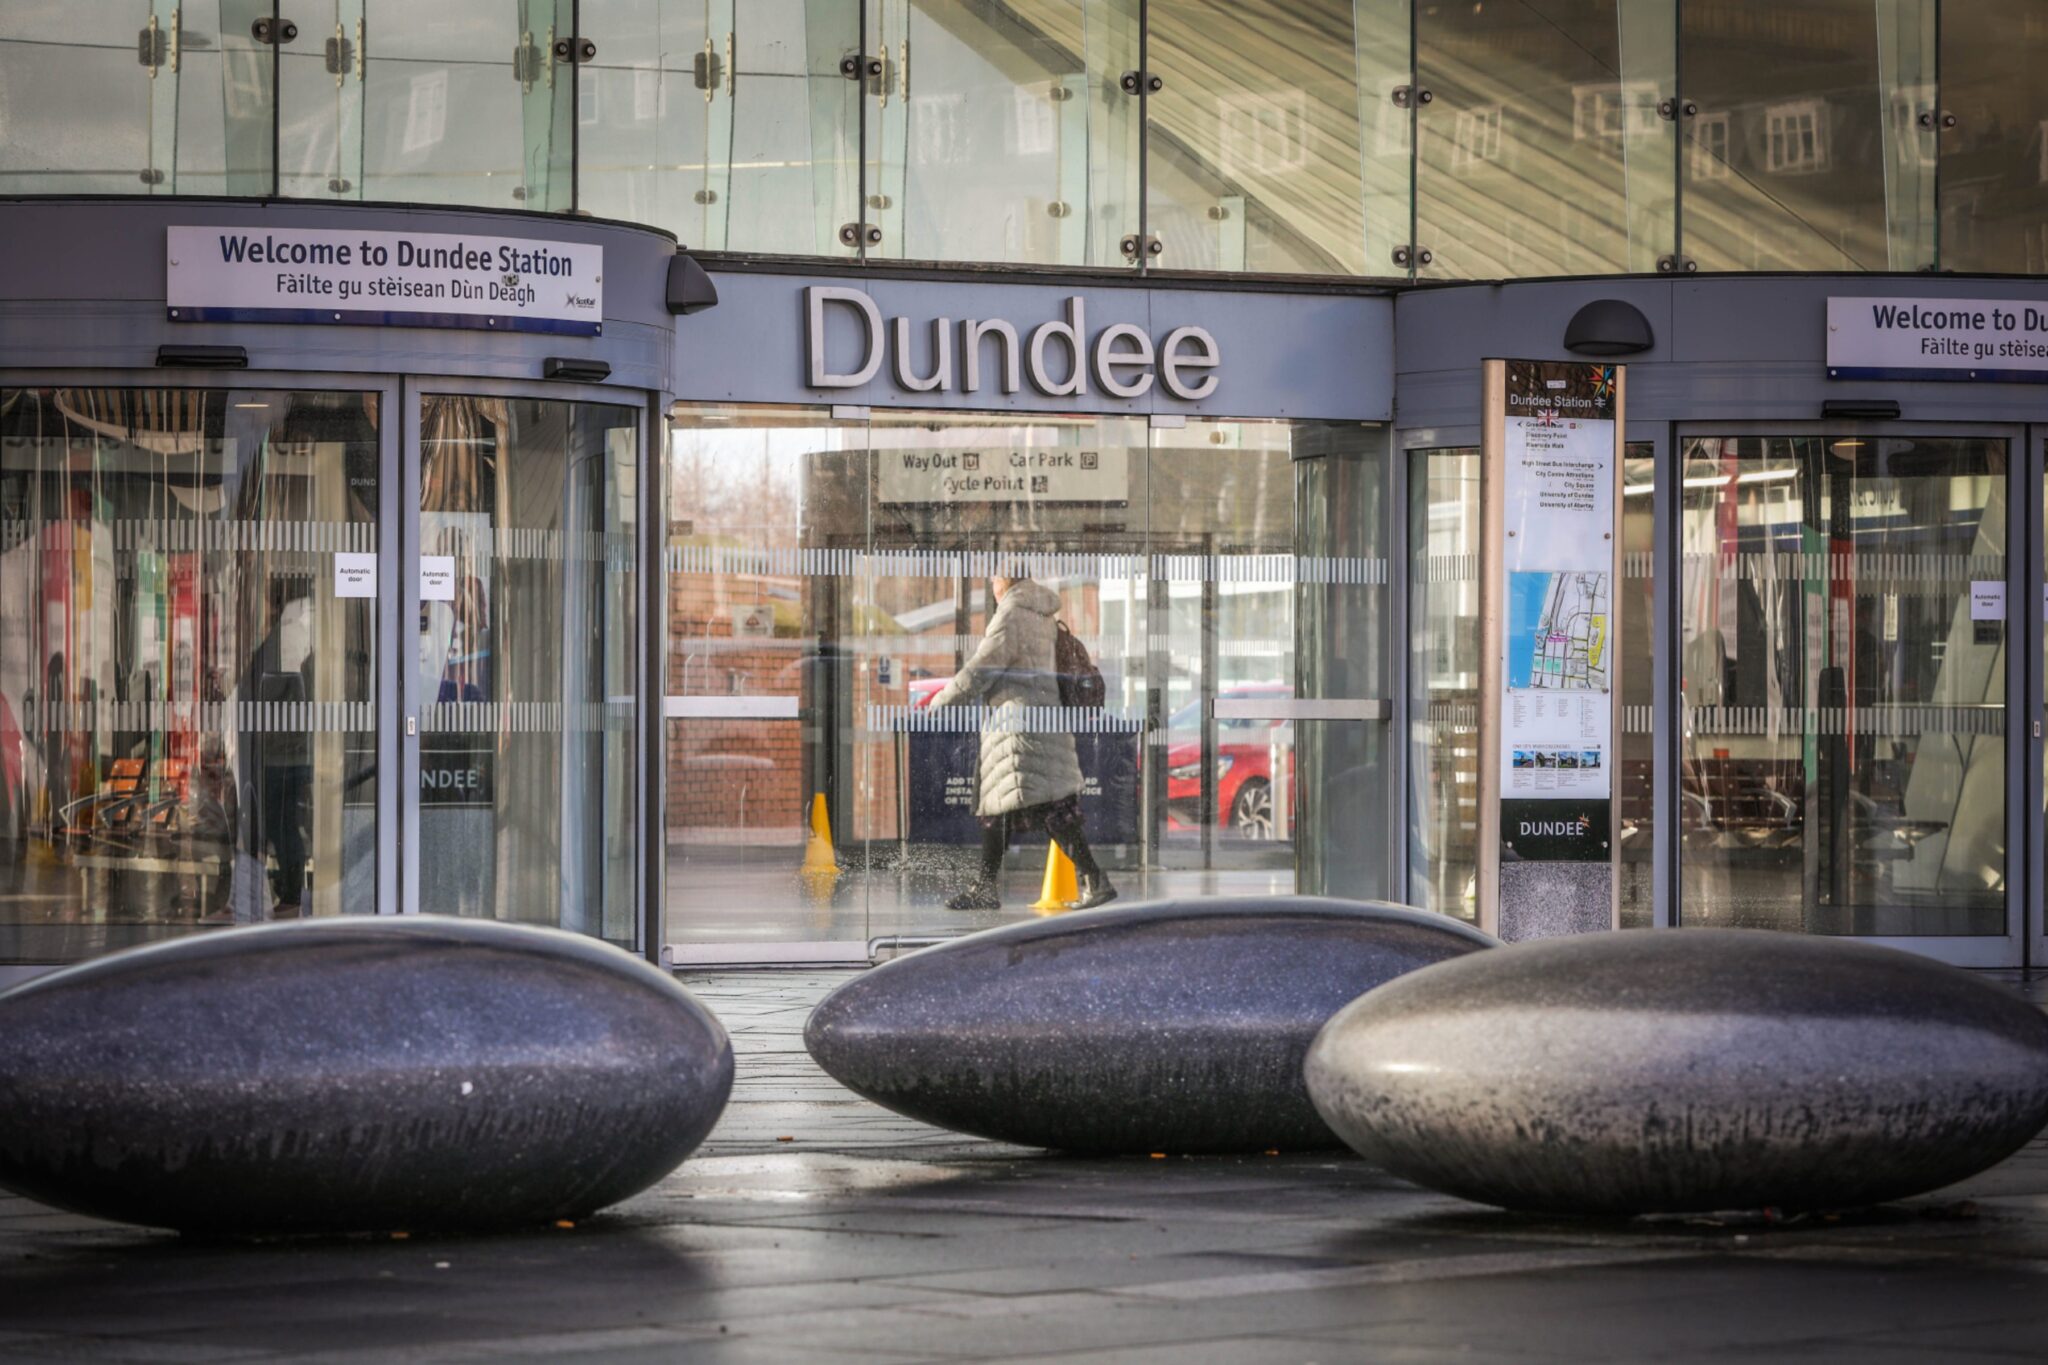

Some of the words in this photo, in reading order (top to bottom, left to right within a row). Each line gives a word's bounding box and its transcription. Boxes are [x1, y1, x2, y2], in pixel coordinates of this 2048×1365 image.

[220, 235, 351, 265] Welcome
[360, 241, 388, 266] to
[398, 241, 492, 271] Dundee
[498, 246, 572, 276] Station
[277, 274, 332, 294] Fàilte
[338, 279, 361, 299] gu
[368, 276, 445, 298] stèisean
[451, 279, 483, 299] Dùn
[1873, 305, 1985, 330] Welcome
[1992, 308, 2016, 331] to
[803, 286, 1220, 400] Dundee
[1921, 338, 1969, 355] Fàilte
[1974, 343, 1994, 360] gu
[1999, 339, 2048, 358] stèise
[1510, 393, 1552, 406] Dundee
[1554, 395, 1592, 408] Station
[903, 453, 929, 472] Way
[932, 453, 957, 468] Out
[1009, 452, 1033, 467] Car
[1038, 452, 1073, 467] Park
[943, 476, 980, 494] Cycle
[984, 476, 1024, 491] Point
[421, 769, 478, 788] NDEE
[1520, 821, 1584, 836] DUNDEE
